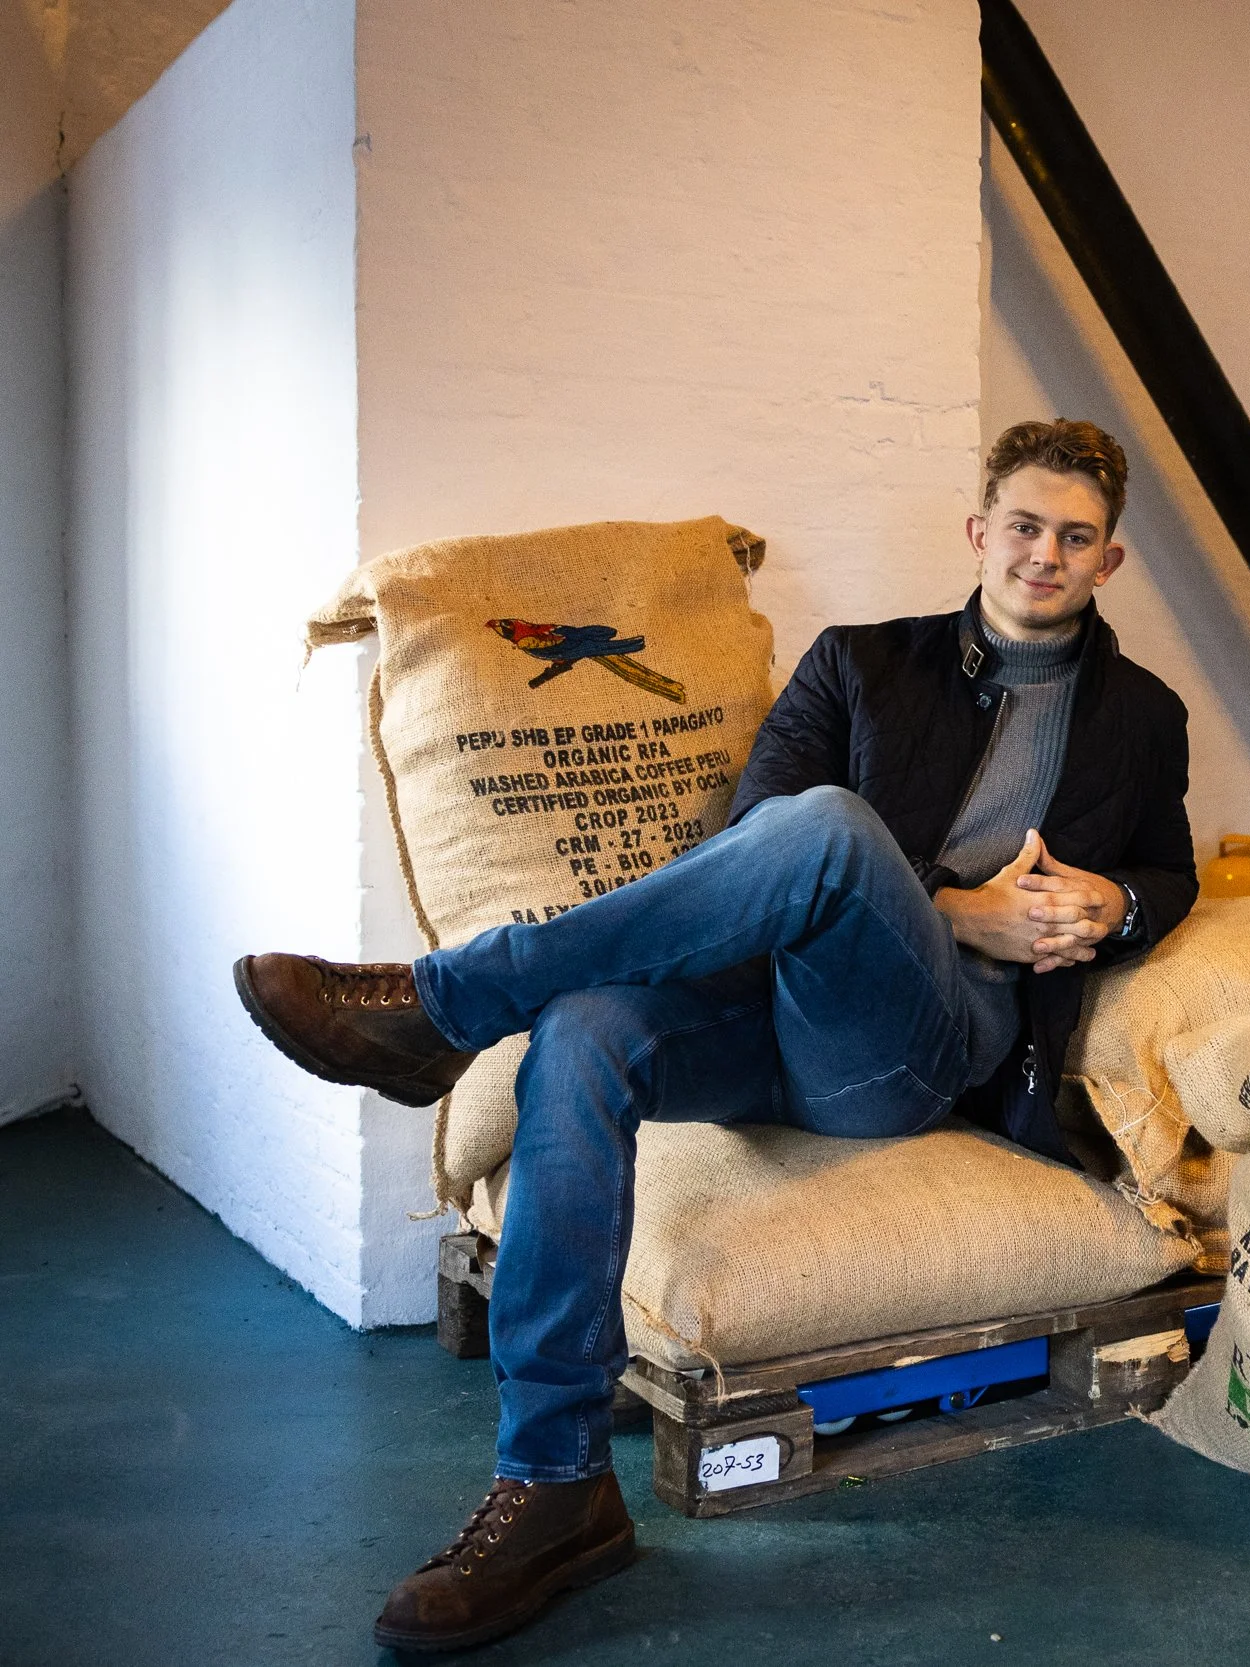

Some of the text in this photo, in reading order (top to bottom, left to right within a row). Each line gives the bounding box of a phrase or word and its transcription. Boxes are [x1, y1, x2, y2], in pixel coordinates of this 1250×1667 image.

[457, 706, 724, 752] PERU SHB EP GRADE 1 PAPAGAYO
[543, 740, 671, 768] ORGANIC RFA
[470, 750, 731, 797] WASHED ARABICA COFFEE PERU
[492, 770, 729, 816] CERTIFIED ORGANIC BY OCIA
[575, 802, 679, 831] CROP 2023
[555, 834, 601, 856] CRM
[620, 829, 642, 850] 27
[662, 820, 703, 843] 2023
[569, 857, 598, 877] PE
[617, 851, 653, 871] BIO
[511, 908, 539, 924] RA
[1230, 1247, 1249, 1284] RA
[702, 1453, 764, 1478] 207-53
